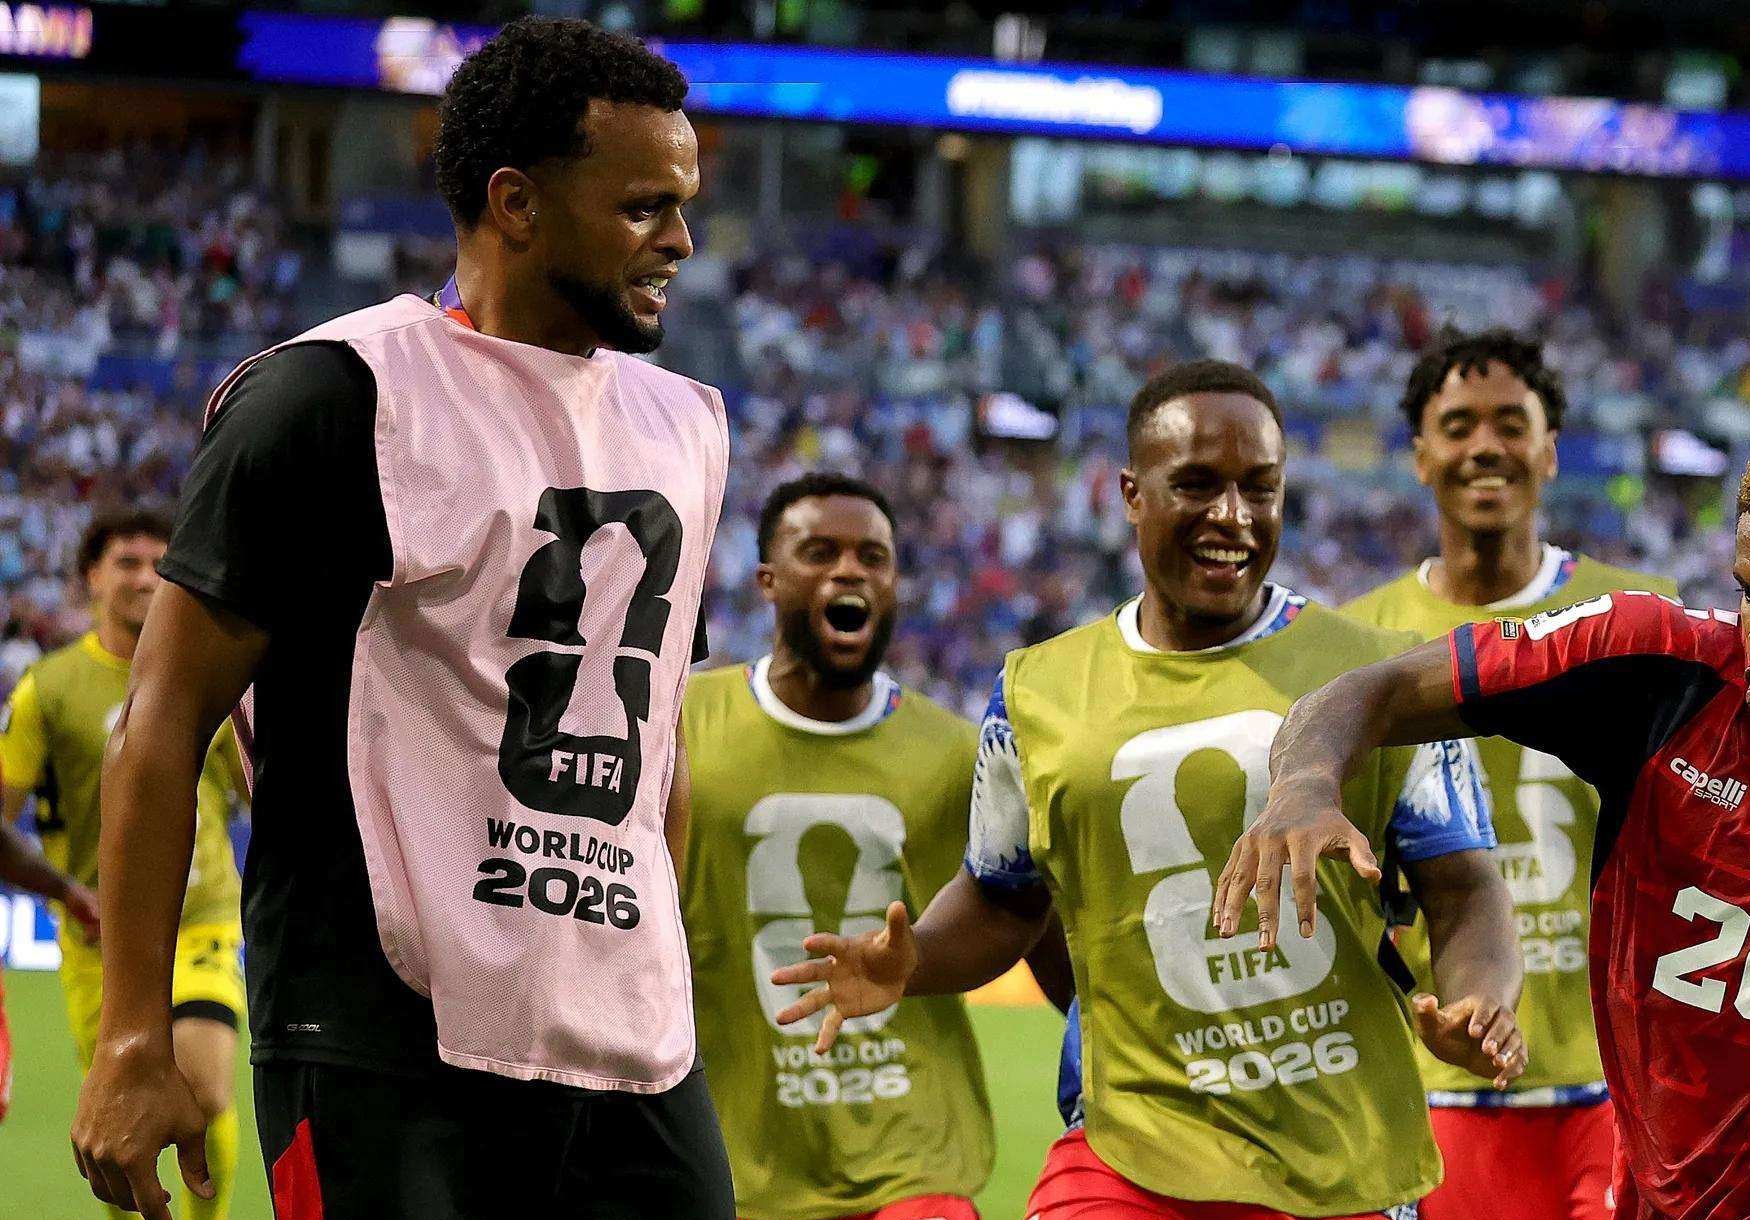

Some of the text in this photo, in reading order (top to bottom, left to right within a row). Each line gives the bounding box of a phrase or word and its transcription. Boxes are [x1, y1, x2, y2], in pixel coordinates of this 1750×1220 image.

[547, 748, 624, 793] FIFA
[1670, 757, 1748, 805] capelli
[1694, 788, 1738, 811] SPORT
[487, 817, 634, 875] WORLD CUP
[472, 857, 641, 931] 2026
[1206, 944, 1292, 987] FIFA
[1174, 999, 1350, 1057] WORLD CUP
[775, 1063, 913, 1109] 2026
[1186, 1031, 1361, 1096] 2026
